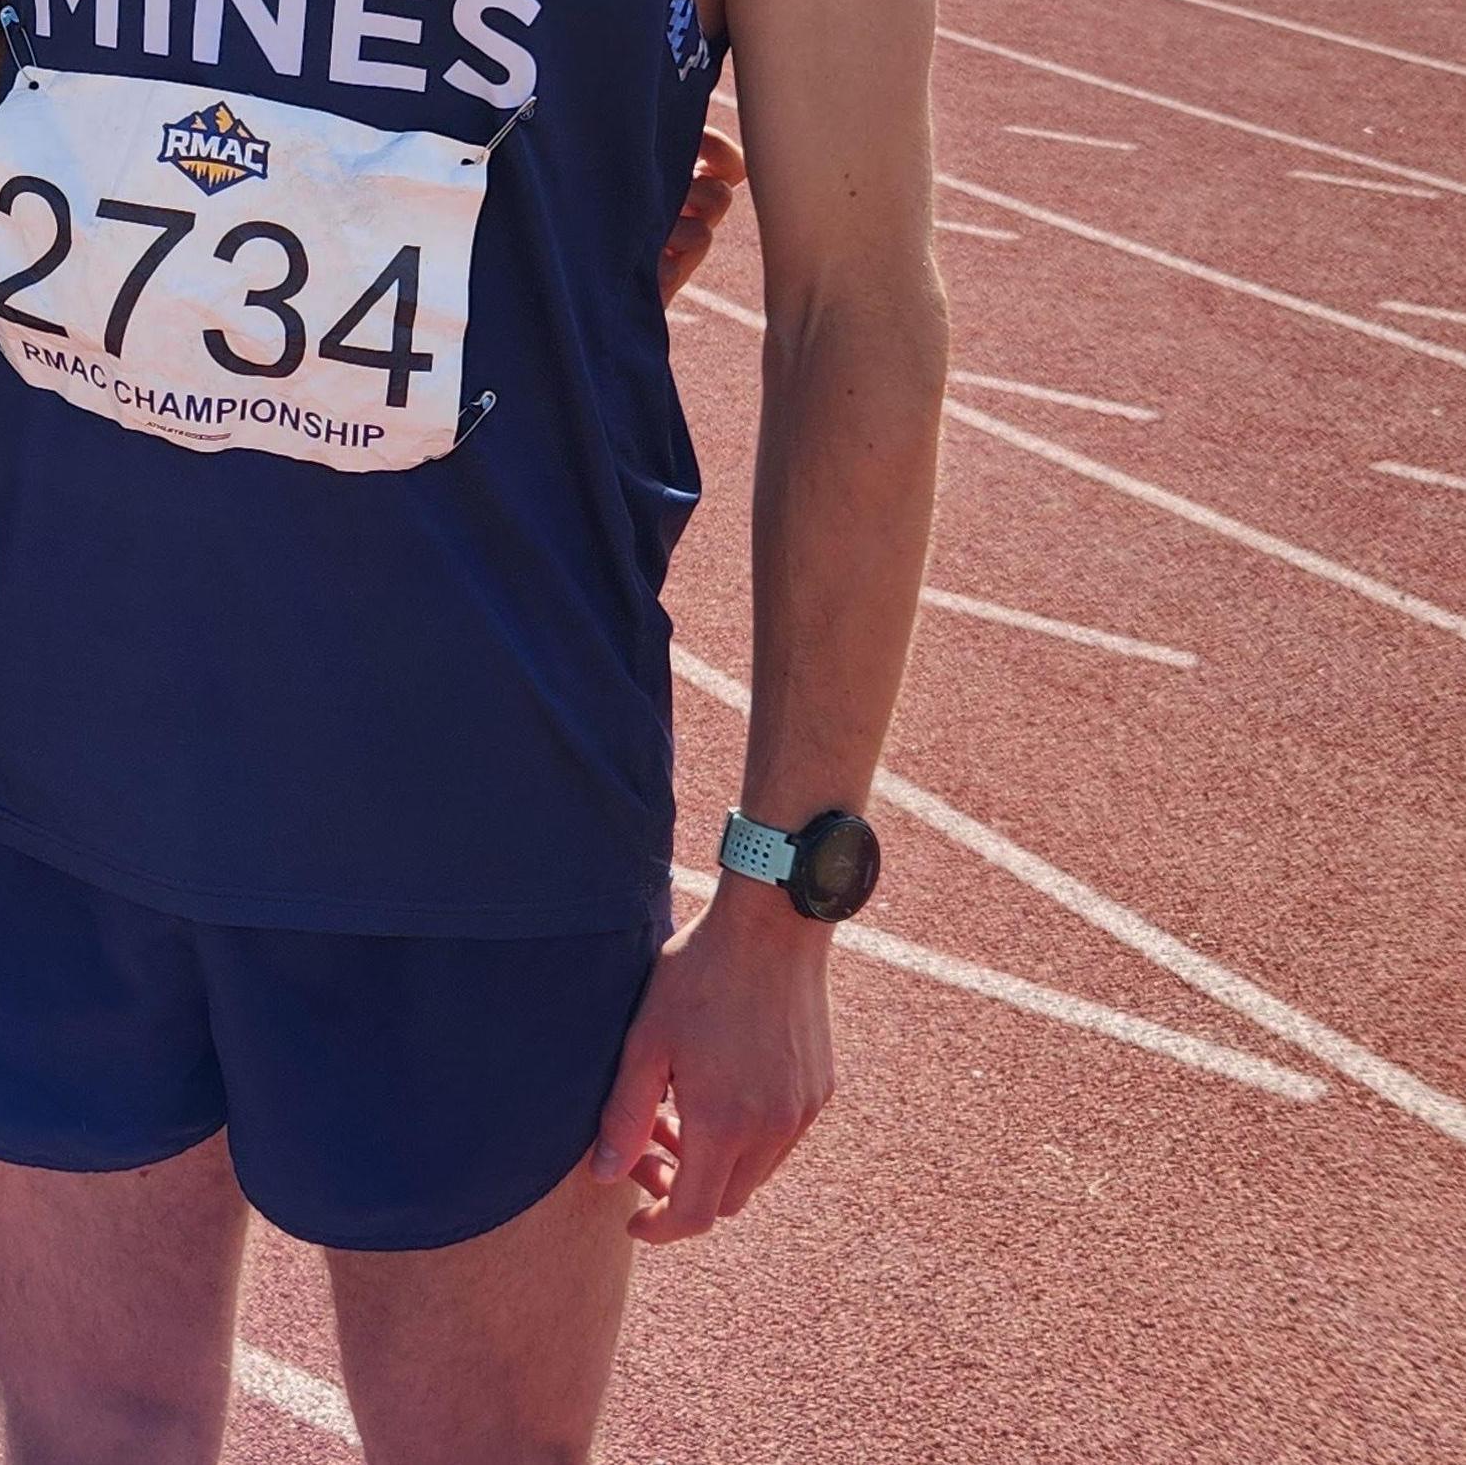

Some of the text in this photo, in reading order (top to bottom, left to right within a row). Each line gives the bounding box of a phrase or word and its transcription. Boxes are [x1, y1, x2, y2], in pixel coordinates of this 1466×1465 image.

[164, 128, 266, 175] RMAC
[21, 340, 385, 449] RMAC CHAMPIONSHIP
